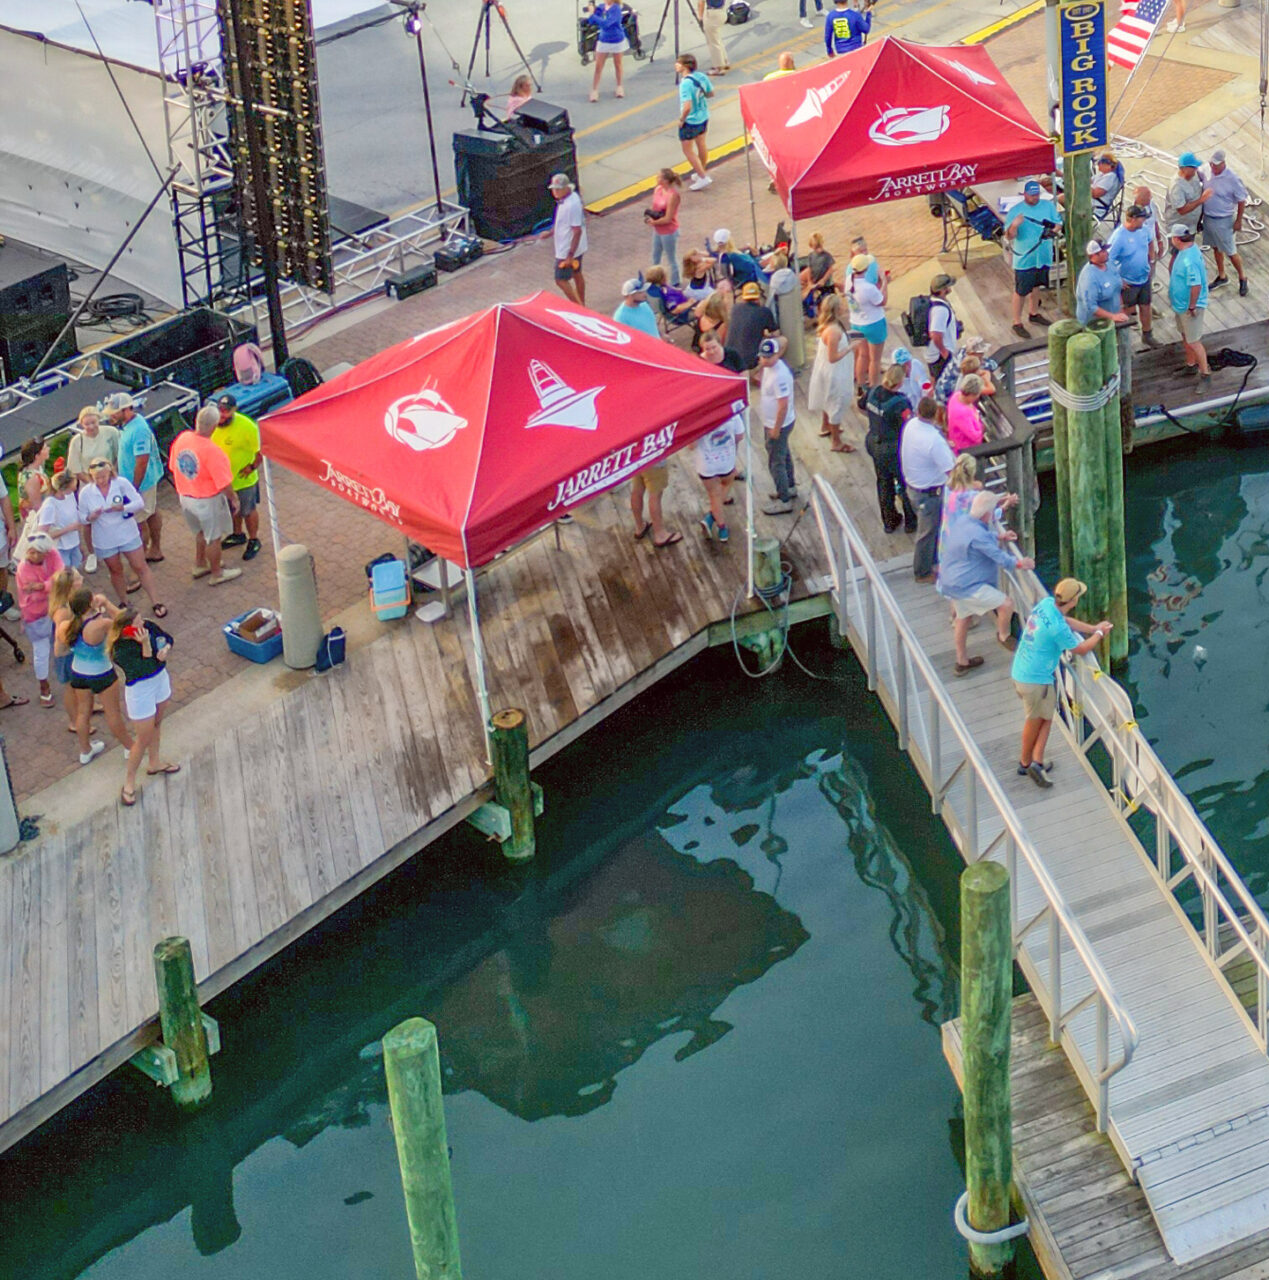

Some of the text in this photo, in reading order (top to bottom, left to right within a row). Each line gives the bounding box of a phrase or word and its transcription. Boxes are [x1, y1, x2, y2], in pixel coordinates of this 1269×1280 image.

[1070, 20, 1099, 147] BIG ROCK
[869, 163, 978, 201] JARRETT BAY
[319, 458, 401, 518] JARRETT BAY
[547, 442, 639, 511] JARRETT
[641, 421, 679, 457] BAY
